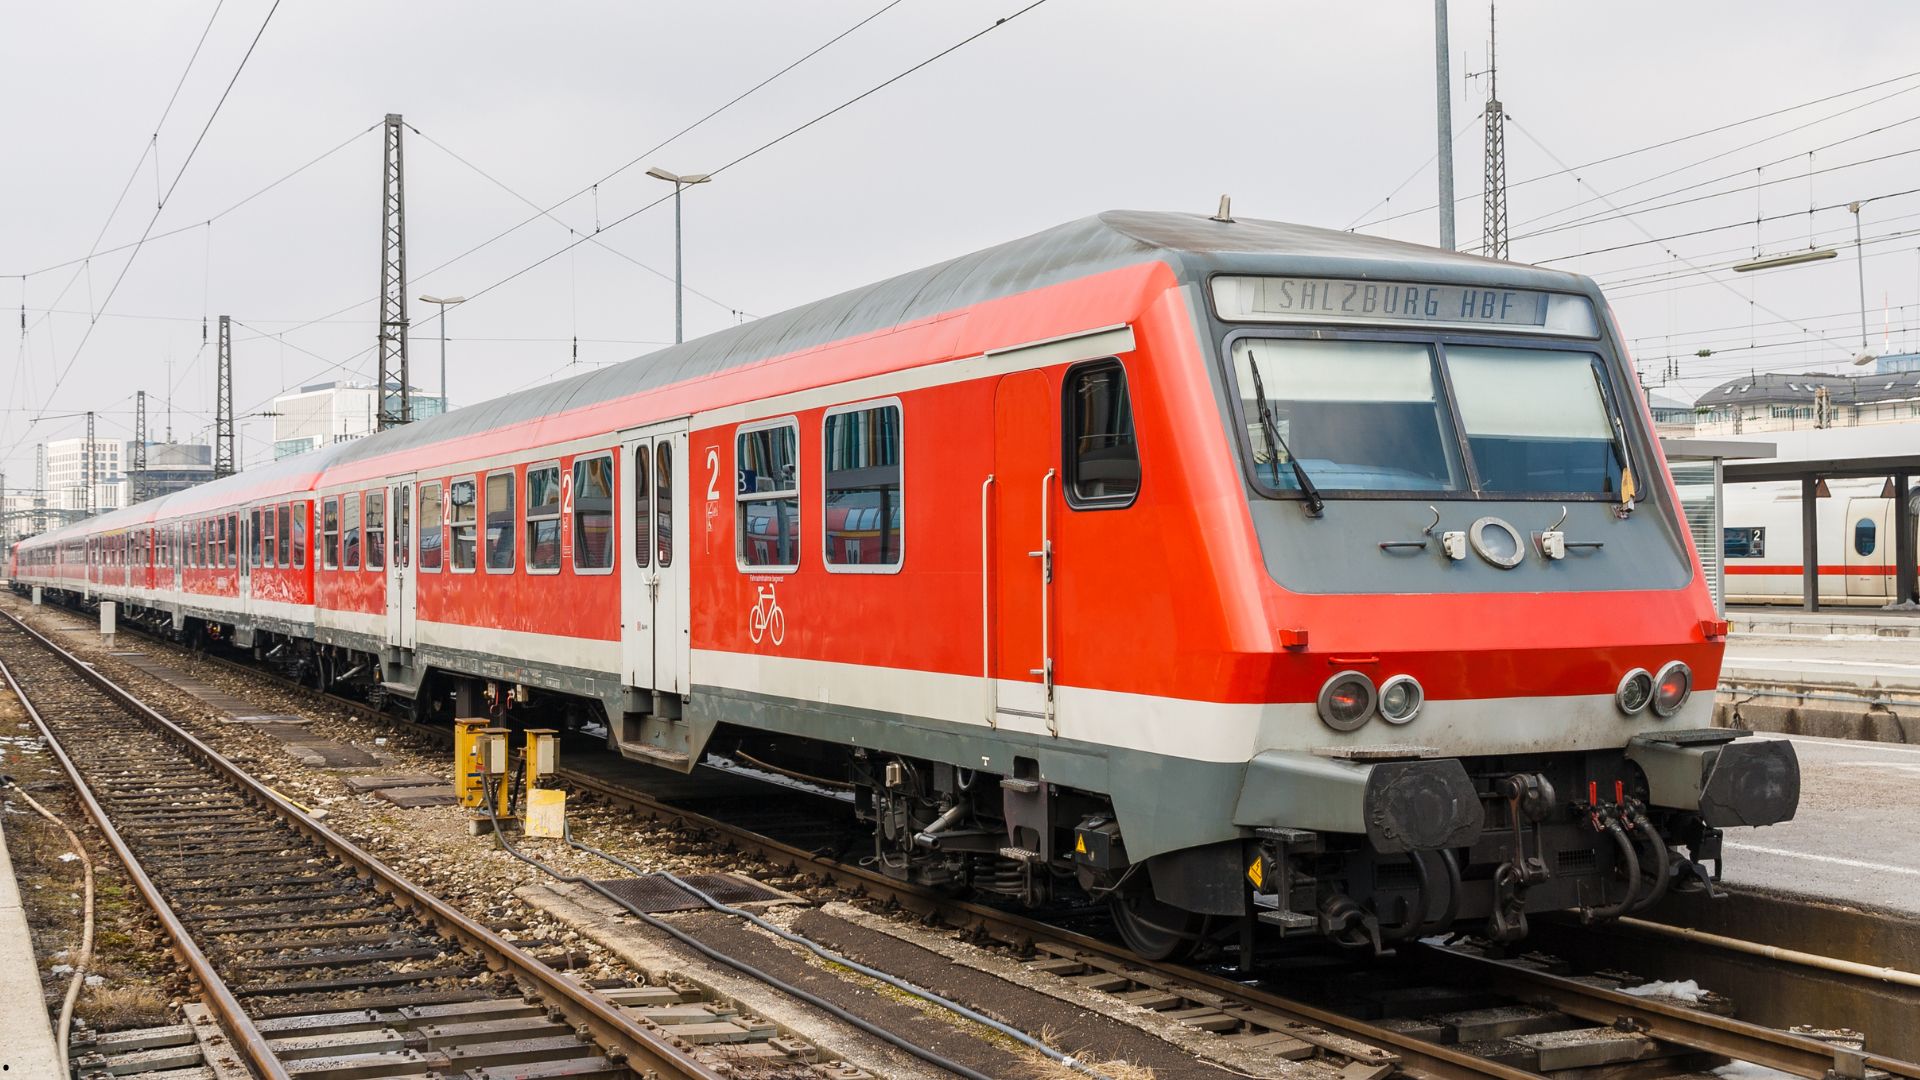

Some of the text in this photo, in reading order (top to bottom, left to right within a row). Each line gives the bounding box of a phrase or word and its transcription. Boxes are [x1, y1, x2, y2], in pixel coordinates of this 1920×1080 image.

[1460, 289, 1517, 320] HBF
[706, 450, 720, 501] 2
[443, 491, 450, 525] 2
[562, 473, 572, 514] 2
[1753, 529, 1761, 541] 2
